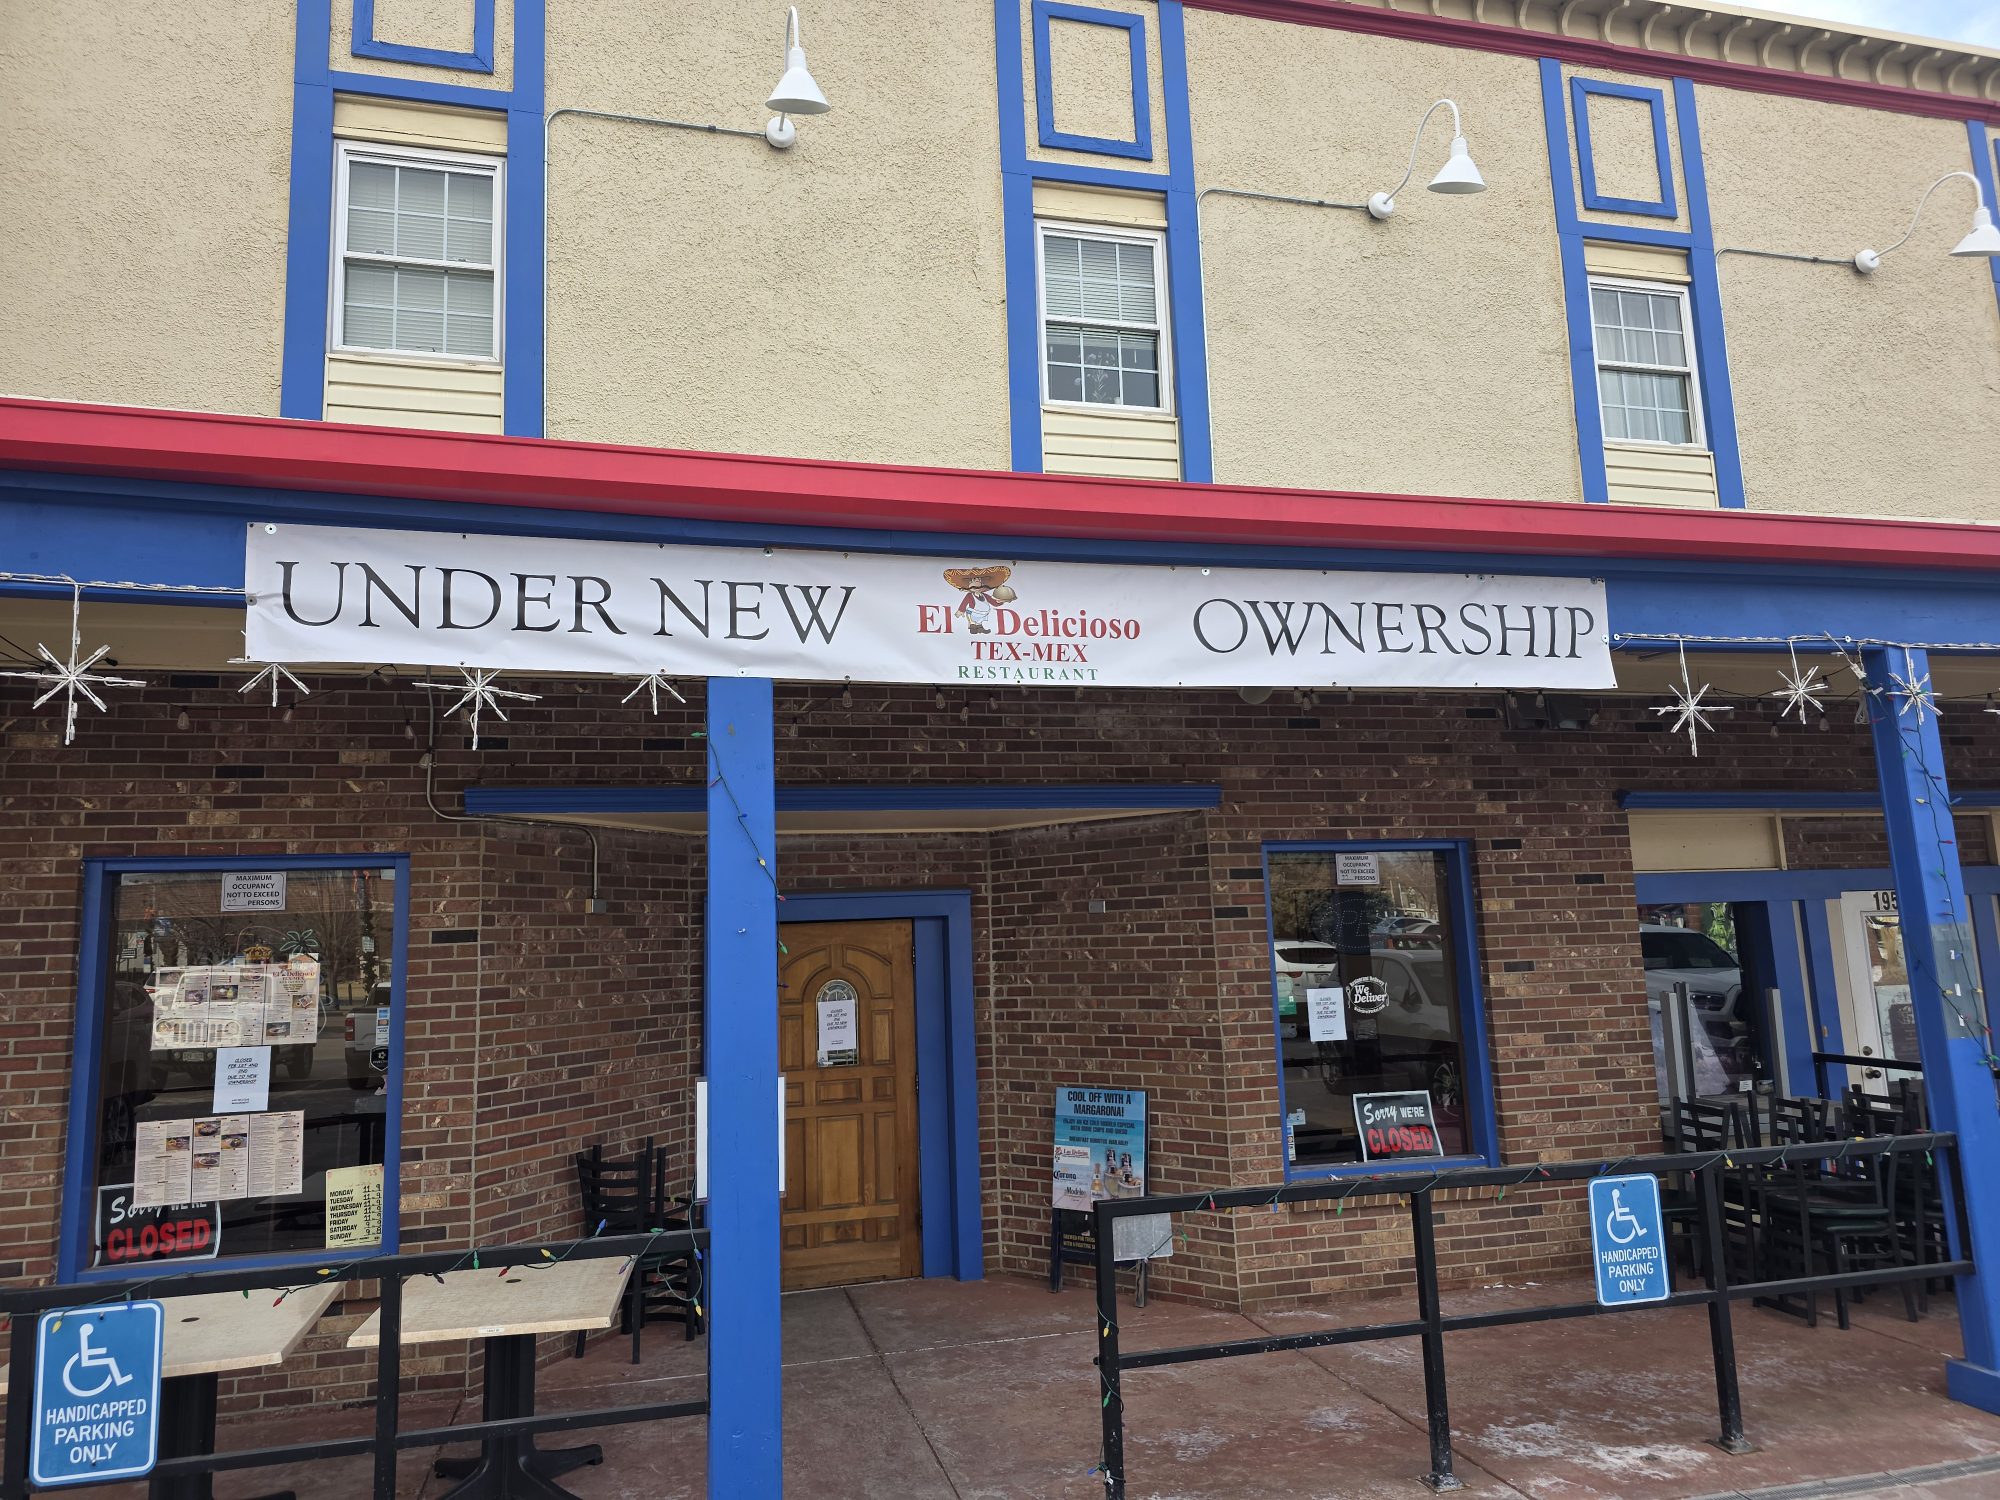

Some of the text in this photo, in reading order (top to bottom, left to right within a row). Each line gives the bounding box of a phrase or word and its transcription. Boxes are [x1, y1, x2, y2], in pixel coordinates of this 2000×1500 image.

[275, 560, 857, 646] UNDER NEW
[916, 604, 1141, 640] El Delicioso
[1193, 597, 1595, 660] OWNERSHIP
[971, 641, 1088, 663] TEX-MEX
[958, 665, 1098, 681] RESTAURANT
[1354, 984, 1370, 995] We
[1354, 992, 1387, 1004] Deliver
[1067, 1091, 1132, 1105] COOL OFF WITH A
[1073, 1104, 1125, 1117] MARGARONA!
[1363, 1103, 1425, 1125] Sorry WE'RE
[1367, 1126, 1434, 1154] CLOSED
[329, 1188, 354, 1197] MONDAY
[329, 1196, 354, 1204] TUESDAY
[329, 1202, 363, 1211] WEDNESDAY
[329, 1210, 358, 1219] THURSDAY
[329, 1218, 349, 1226] FRIDAY
[329, 1224, 358, 1233] SATURDAY
[107, 1218, 211, 1260] CLOSED
[1601, 1246, 1658, 1264] HANDICAPPED
[1608, 1262, 1654, 1279] PARKING
[1619, 1278, 1646, 1293] ONLY
[46, 1398, 147, 1426] HANDICAPPED
[54, 1419, 135, 1446] PARKING
[69, 1442, 118, 1465] ONLY
